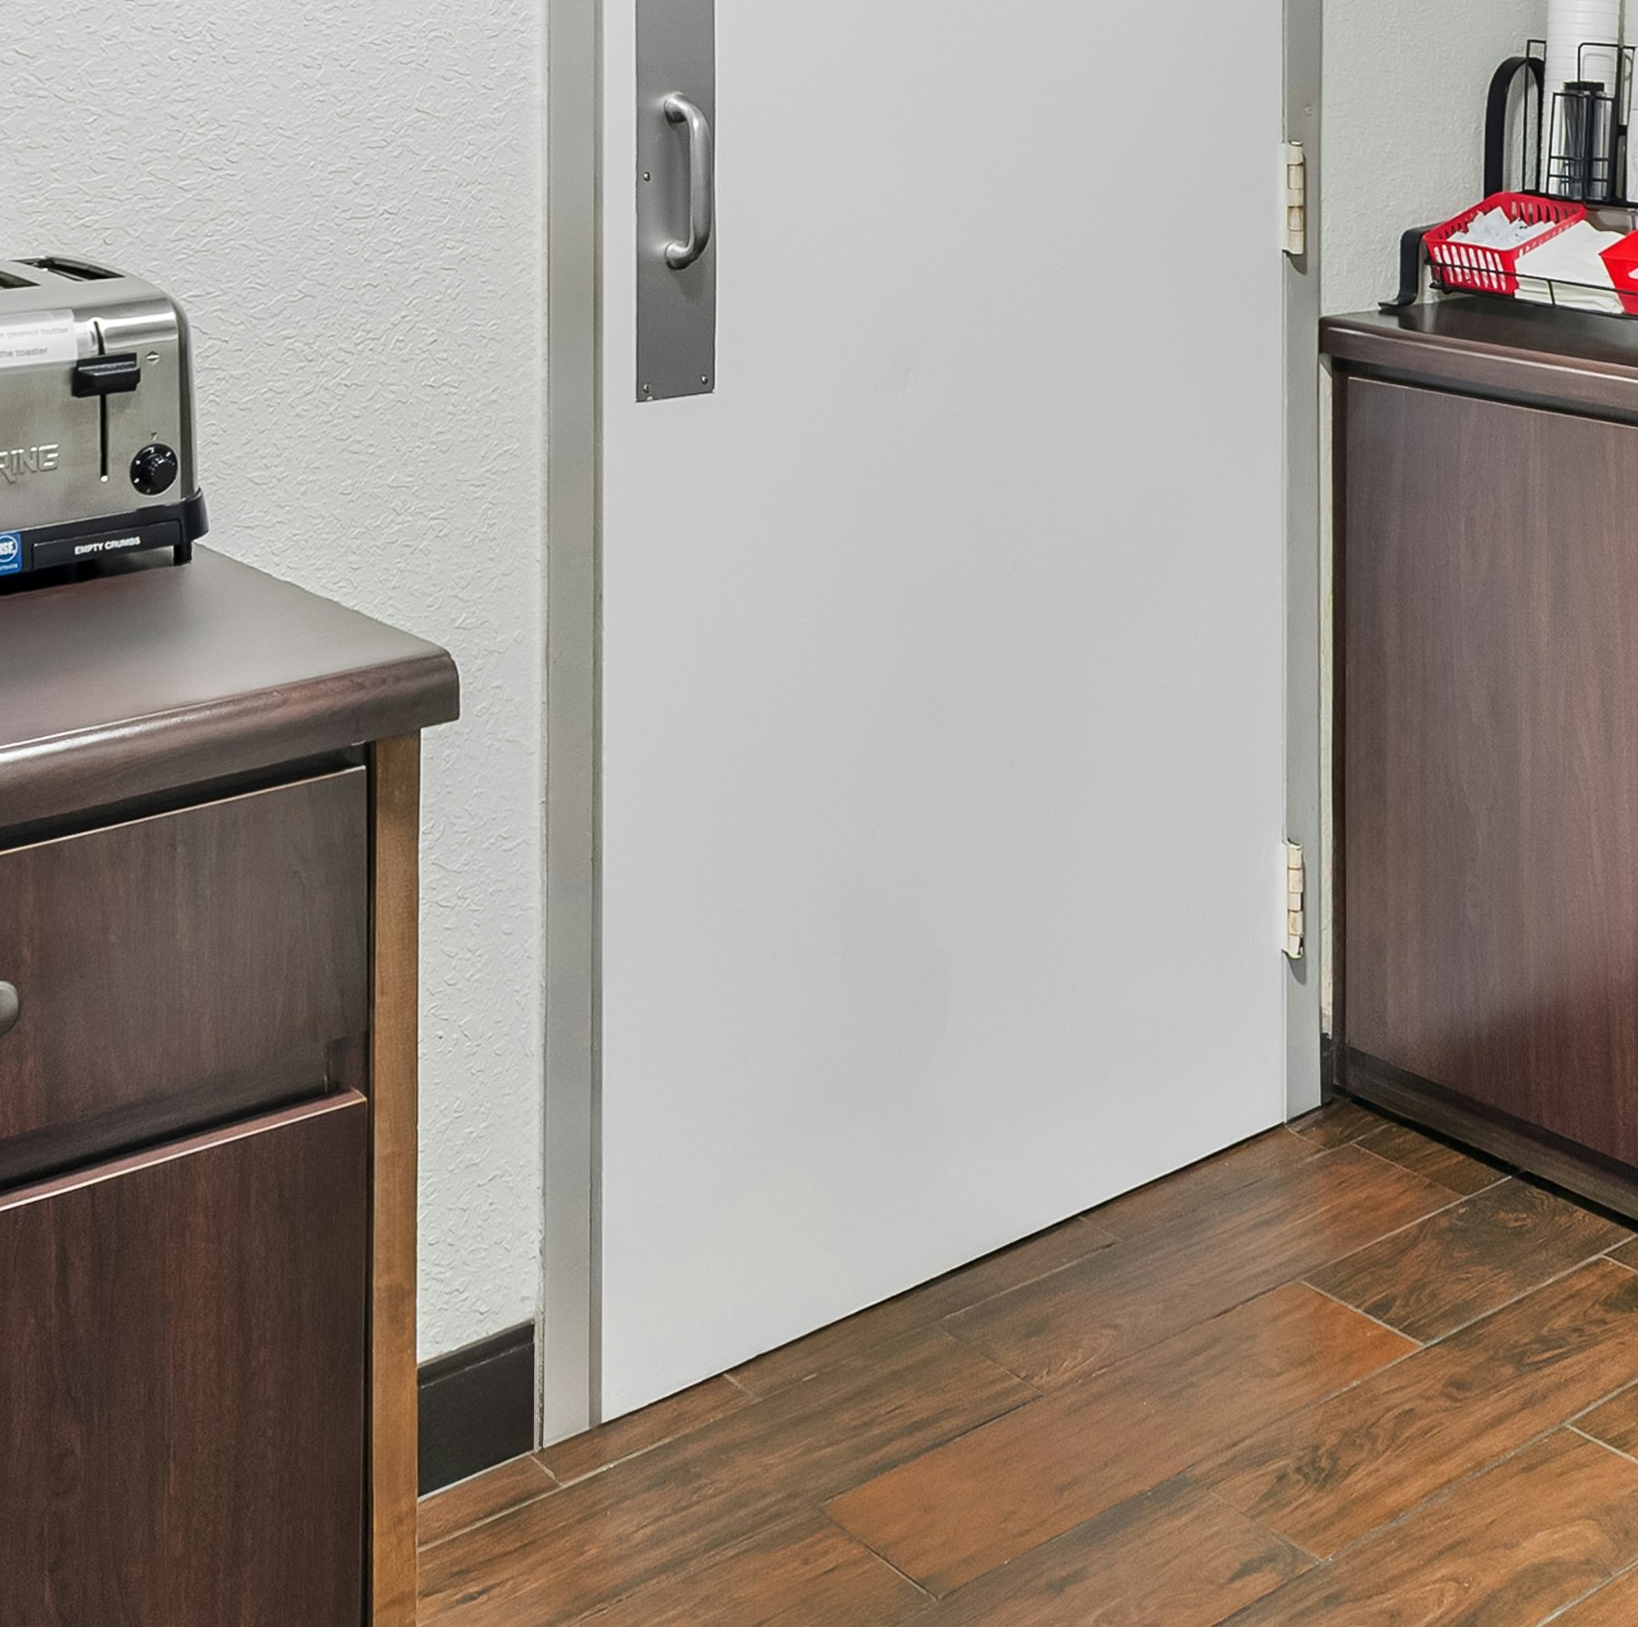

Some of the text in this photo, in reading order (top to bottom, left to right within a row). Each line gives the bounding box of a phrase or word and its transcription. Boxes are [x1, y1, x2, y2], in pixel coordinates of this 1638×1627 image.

[0, 348, 13, 358] the
[15, 346, 48, 357] toaster
[75, 536, 141, 555] EMPTY CRUMBS
